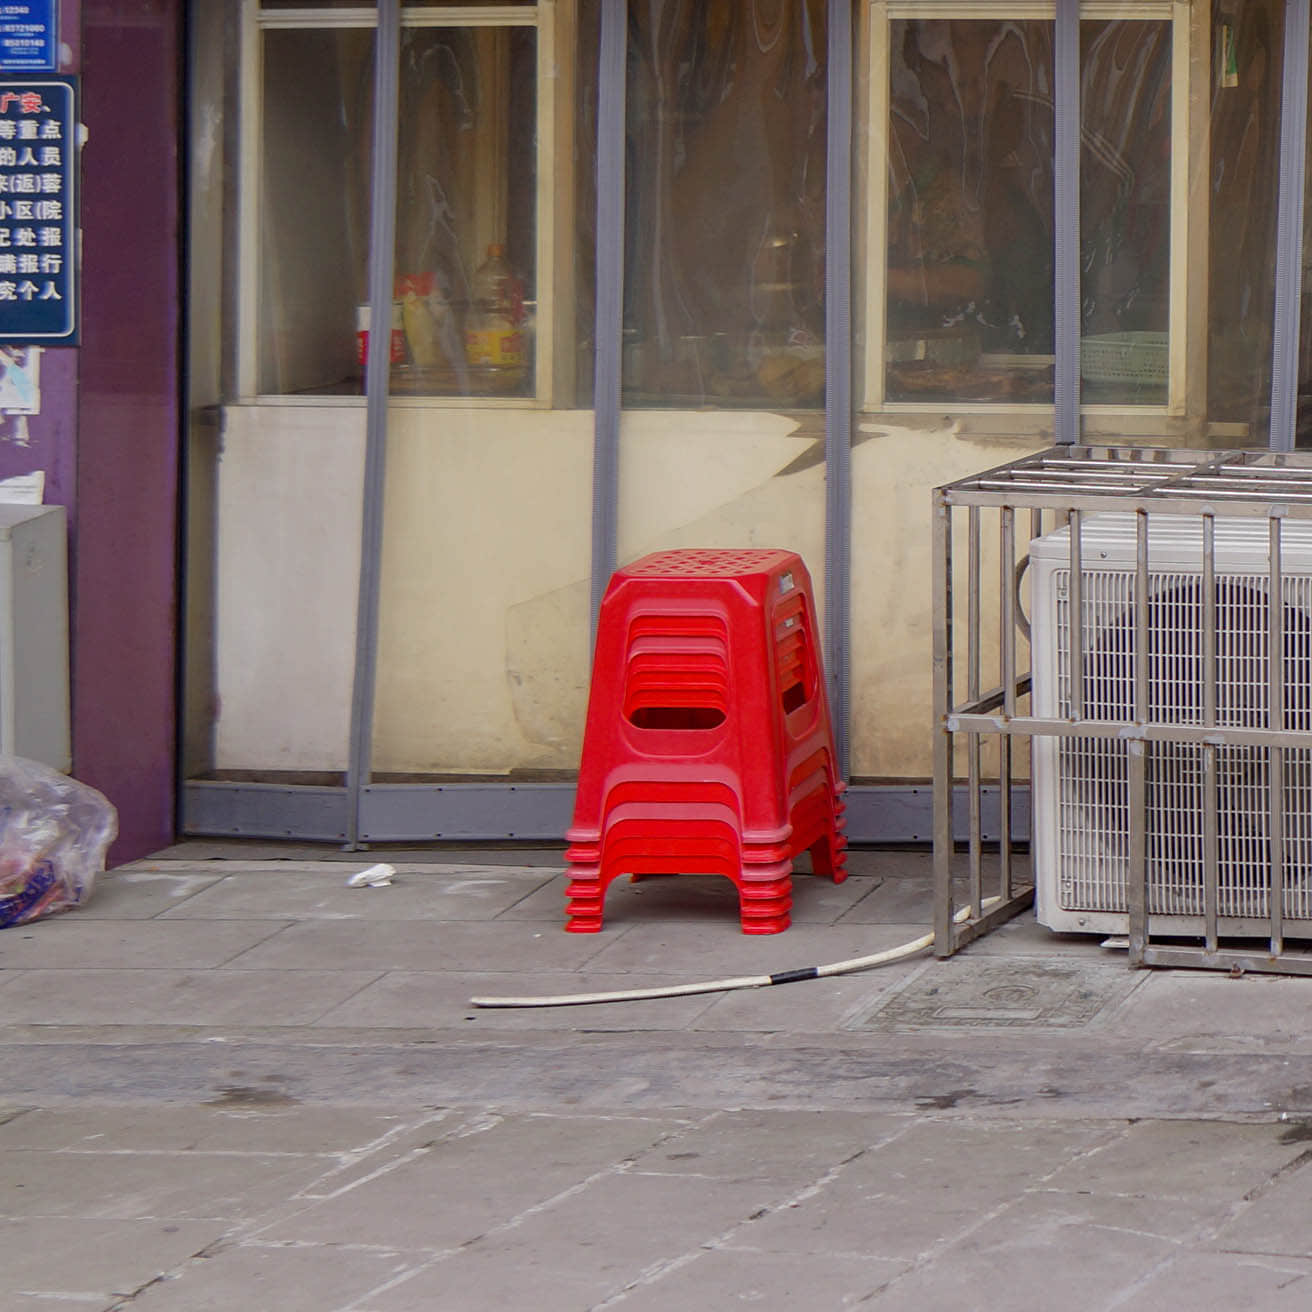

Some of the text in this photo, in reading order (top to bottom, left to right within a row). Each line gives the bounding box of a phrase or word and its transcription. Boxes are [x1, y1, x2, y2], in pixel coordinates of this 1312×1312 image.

[0, 119, 62, 140] 等重点
[0, 146, 62, 166] 的人员
